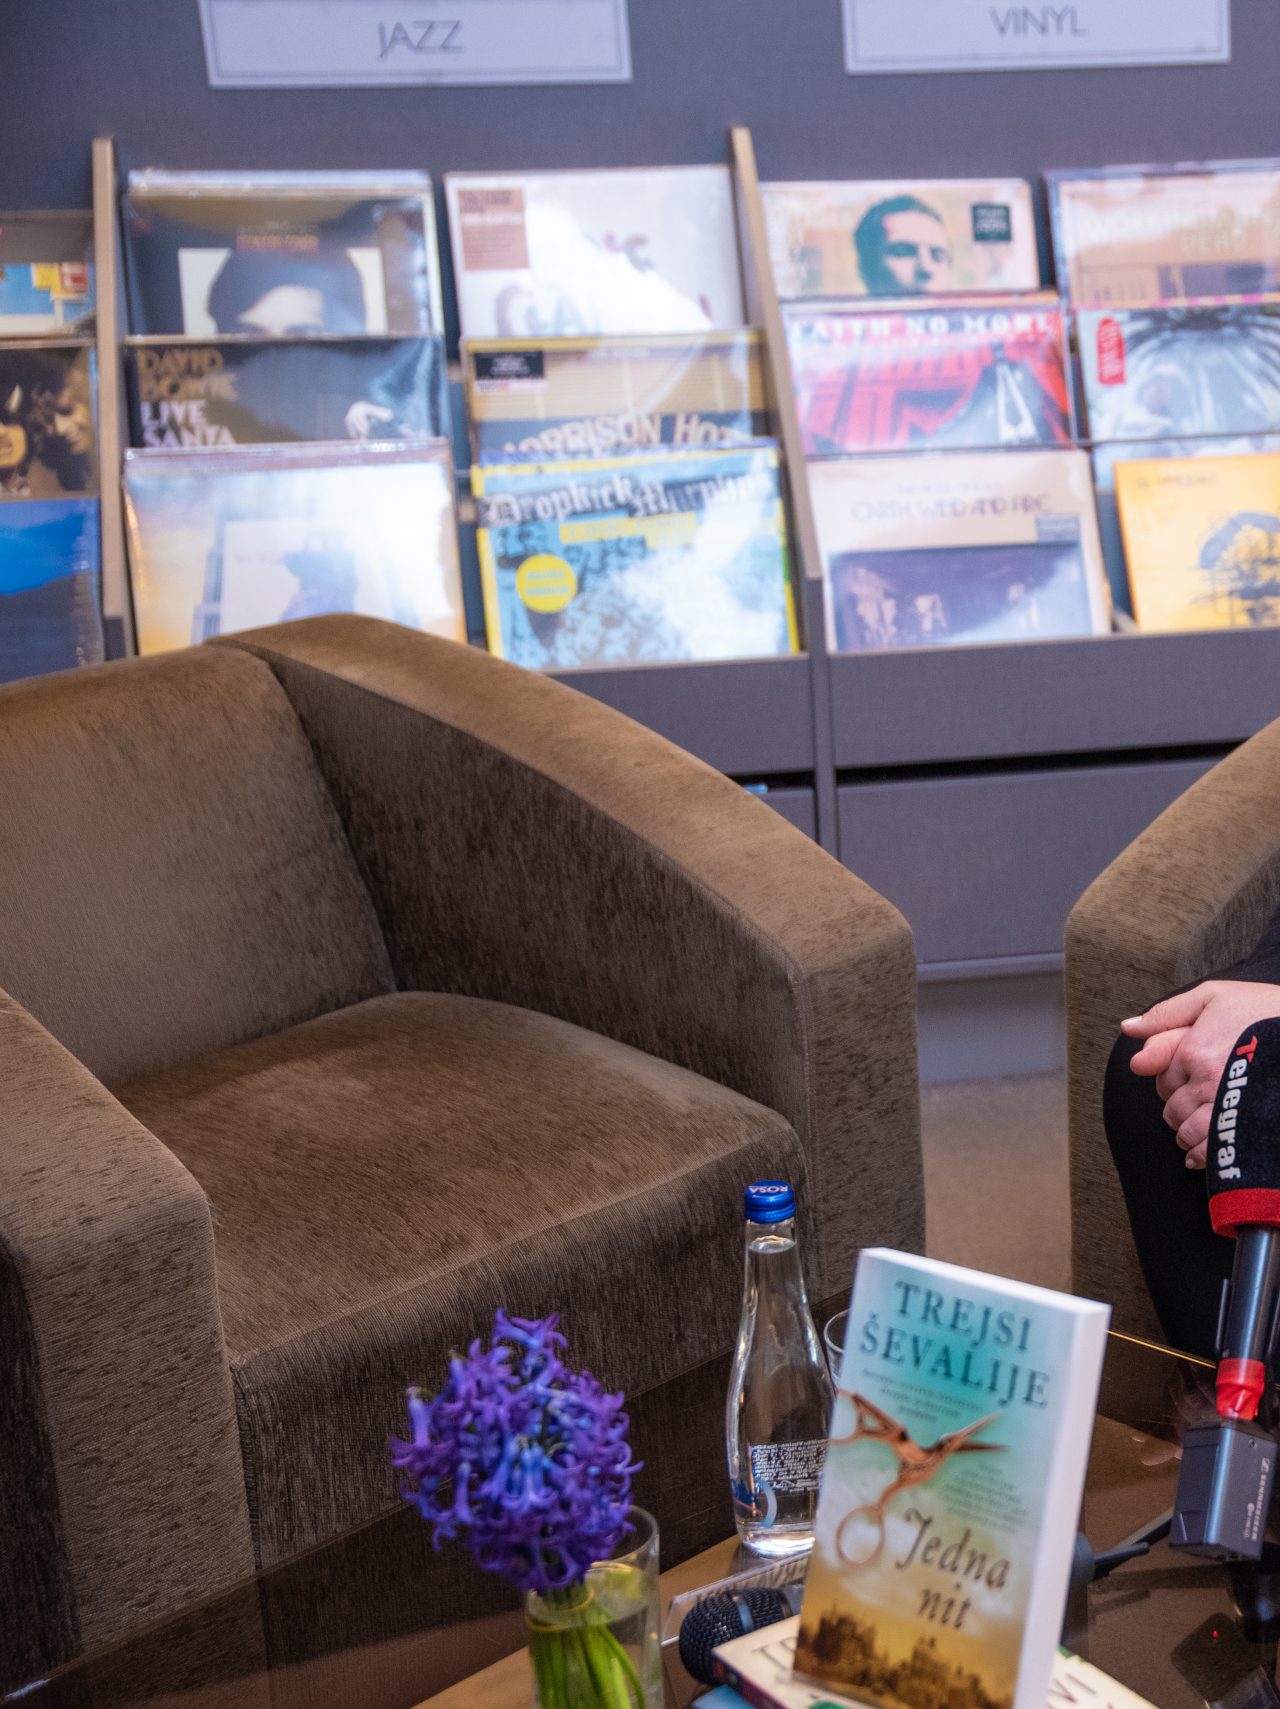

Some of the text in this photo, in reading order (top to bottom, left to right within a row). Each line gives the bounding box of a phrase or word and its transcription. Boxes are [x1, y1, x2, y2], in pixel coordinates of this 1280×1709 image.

[377, 19, 464, 60] JAZZ
[987, 4, 1089, 38] VINYL
[904, 314, 951, 335] NO
[136, 349, 225, 377] DAVID
[140, 400, 207, 426] LIVE
[143, 424, 237, 447] SANTA
[484, 472, 632, 524] Dropkick
[1217, 1035, 1258, 1181] Telegraf
[748, 1185, 789, 1194] ROSA
[895, 1280, 1033, 1353] TREJSI
[859, 1312, 1051, 1411] ŠEVALIJE
[894, 1507, 1012, 1590] Jedna
[917, 1581, 972, 1629] nit
